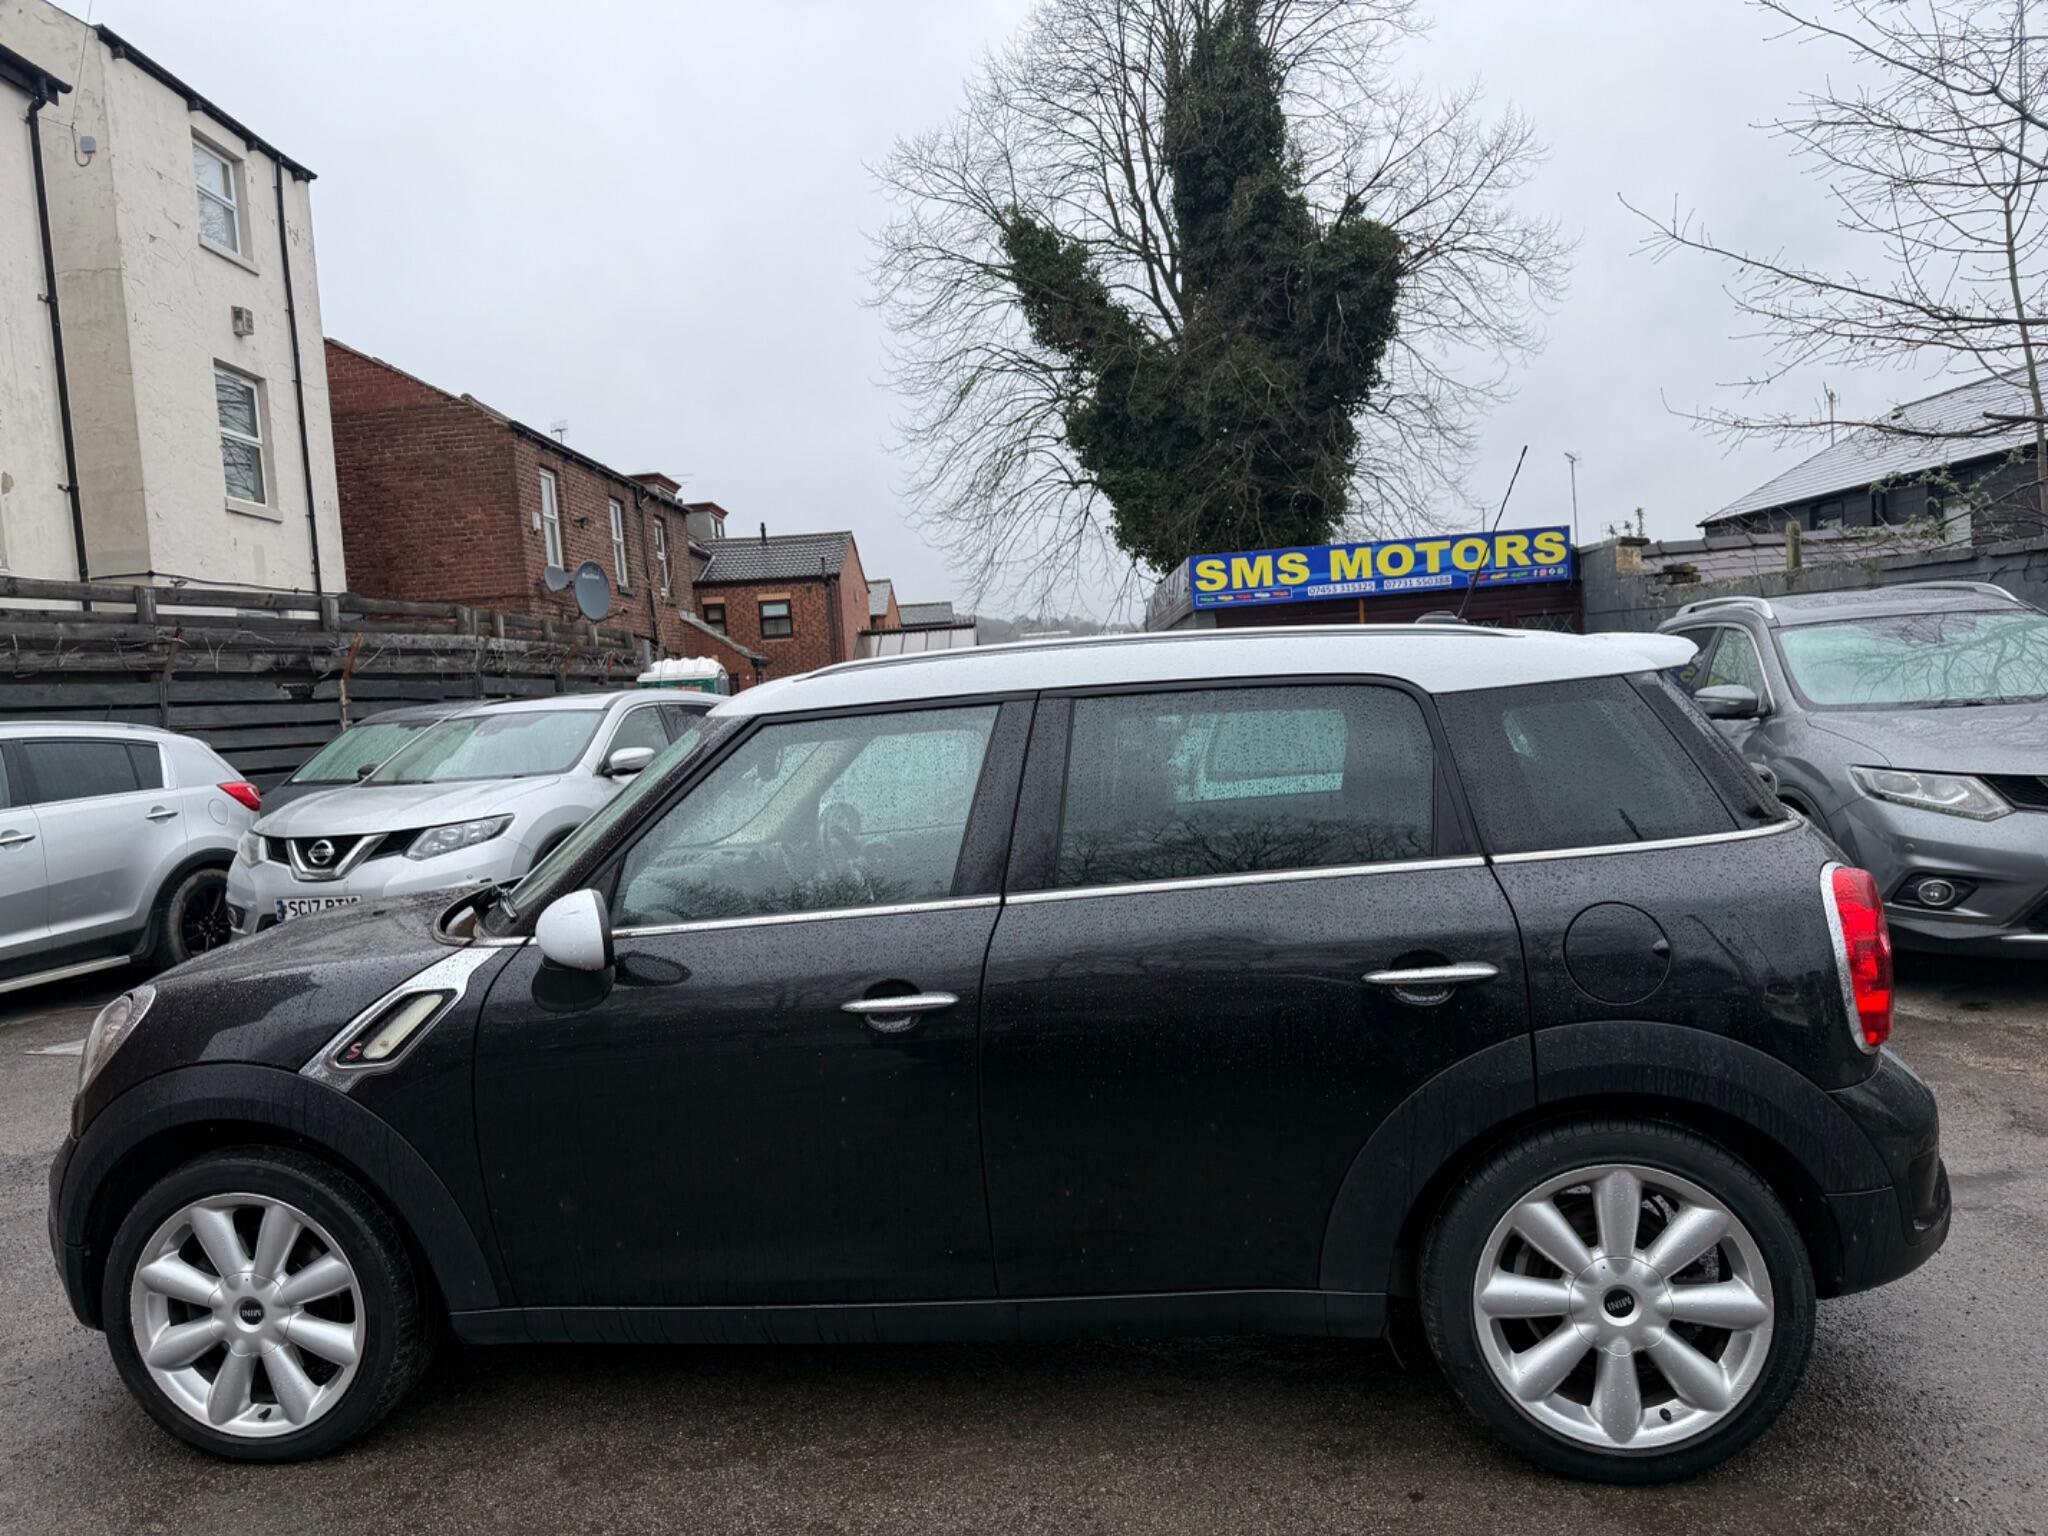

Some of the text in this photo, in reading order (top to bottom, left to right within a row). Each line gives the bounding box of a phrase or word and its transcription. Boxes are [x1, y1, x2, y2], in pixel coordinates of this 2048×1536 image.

[1197, 533, 1566, 591] SMS MOTORS
[288, 899, 321, 917] SC17
[1606, 1295, 1632, 1311] MINI
